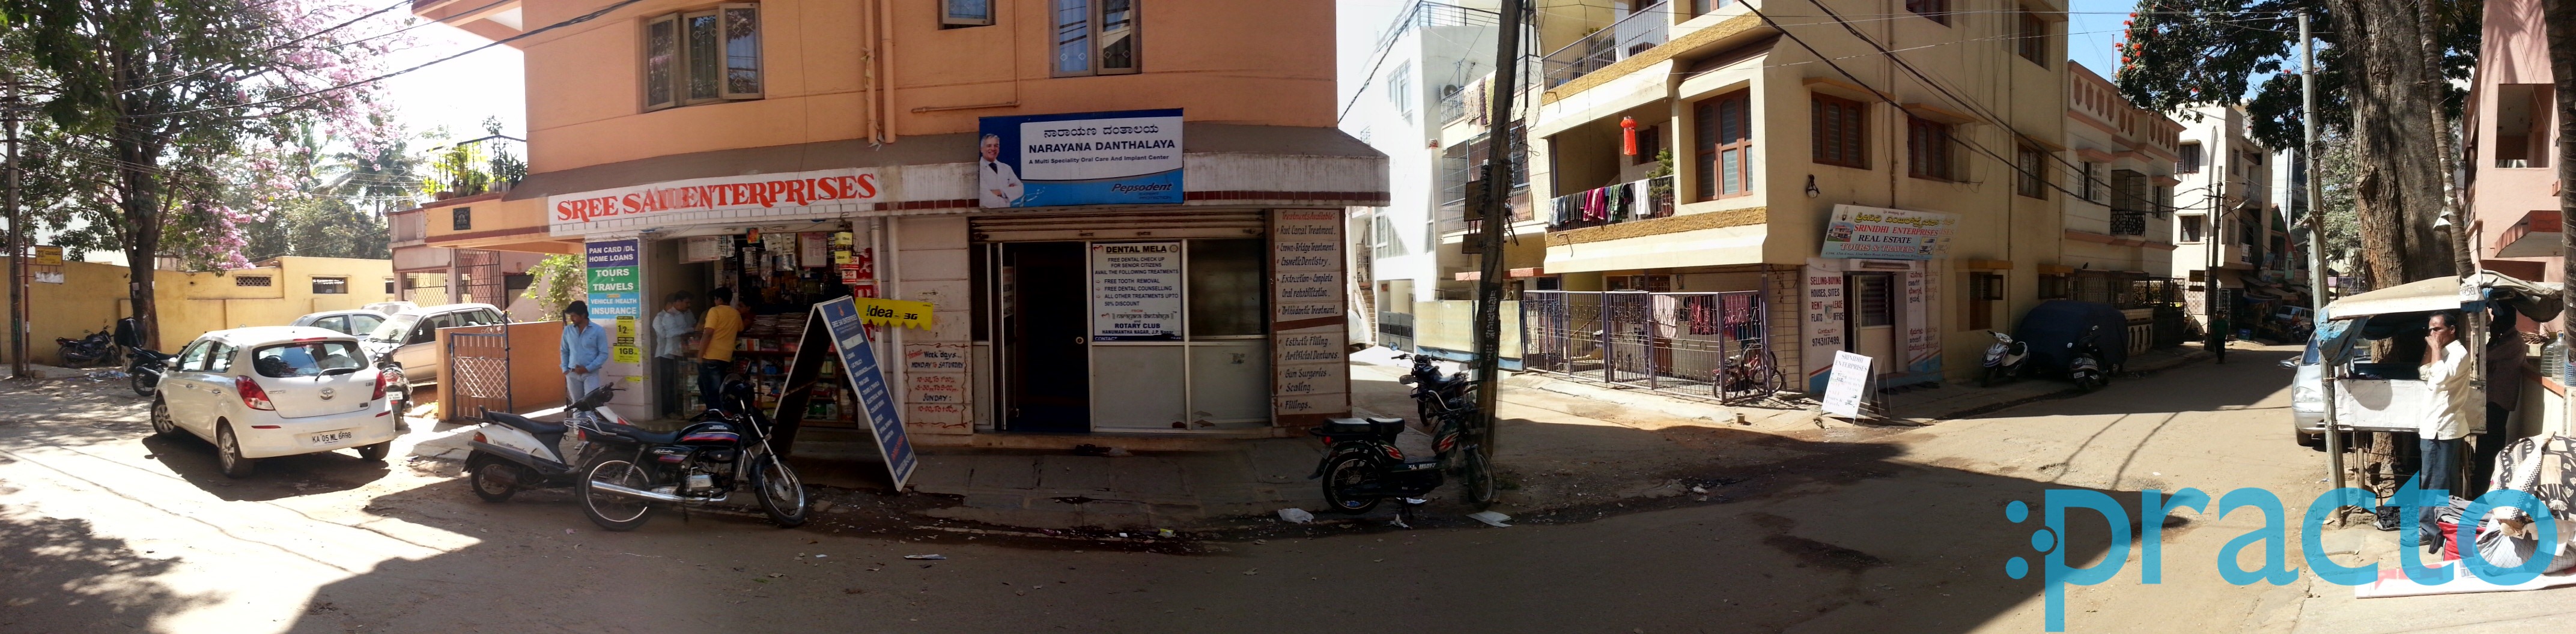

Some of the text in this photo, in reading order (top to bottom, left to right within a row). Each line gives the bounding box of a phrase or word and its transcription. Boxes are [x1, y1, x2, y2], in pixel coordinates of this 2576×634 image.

[1029, 140, 1175, 153] NARAYANA DANTHALAYA
[1111, 183, 1173, 194] Pepsodent
[557, 196, 618, 222] SREE
[678, 173, 876, 208] ENTERPRISES
[1280, 225, 1290, 235] Root
[1292, 225, 1307, 235] Canal
[1854, 224, 1939, 236] SRINIDHI ENTERPRISES
[1281, 256, 1301, 266] Cosmetic
[595, 268, 630, 277] TOURS
[1313, 274, 1333, 284] Complete
[593, 282, 634, 291] TRAVELS
[1282, 288, 1293, 298] Oral
[1812, 300, 1842, 310] RENT LEASE
[1833, 312, 1844, 321] OFFICE
[1835, 360, 1867, 372] ENTERPRISES
[1285, 369, 1297, 378] Gum
